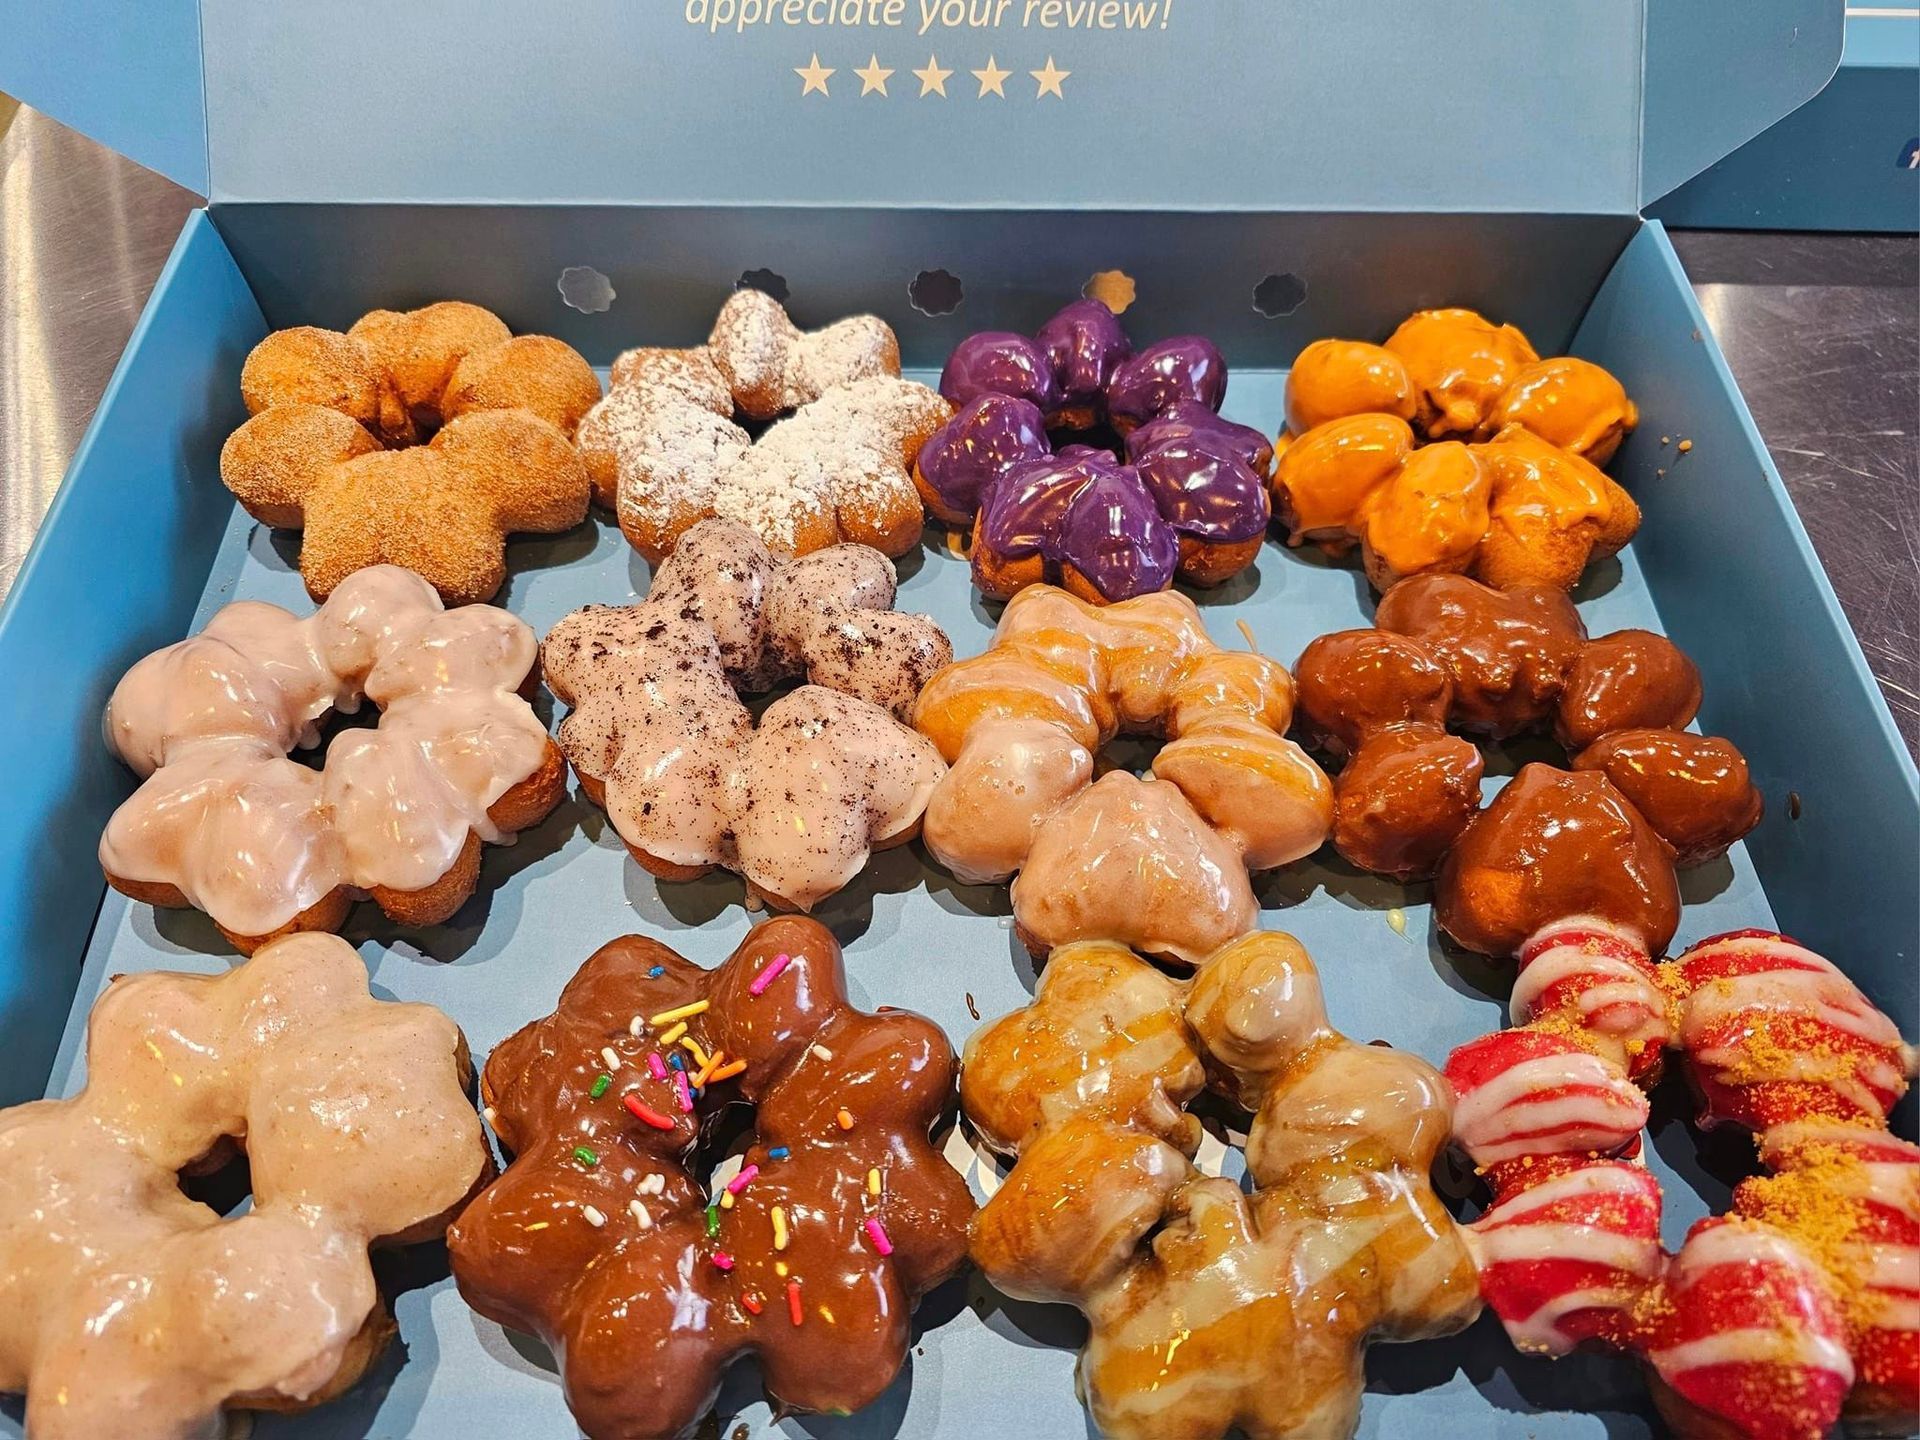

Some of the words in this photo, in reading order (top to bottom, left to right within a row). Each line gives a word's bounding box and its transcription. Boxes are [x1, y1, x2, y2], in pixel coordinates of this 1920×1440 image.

[684, 0, 906, 34] appreciate
[917, 0, 1013, 36] your
[1022, 0, 1173, 30] review!
